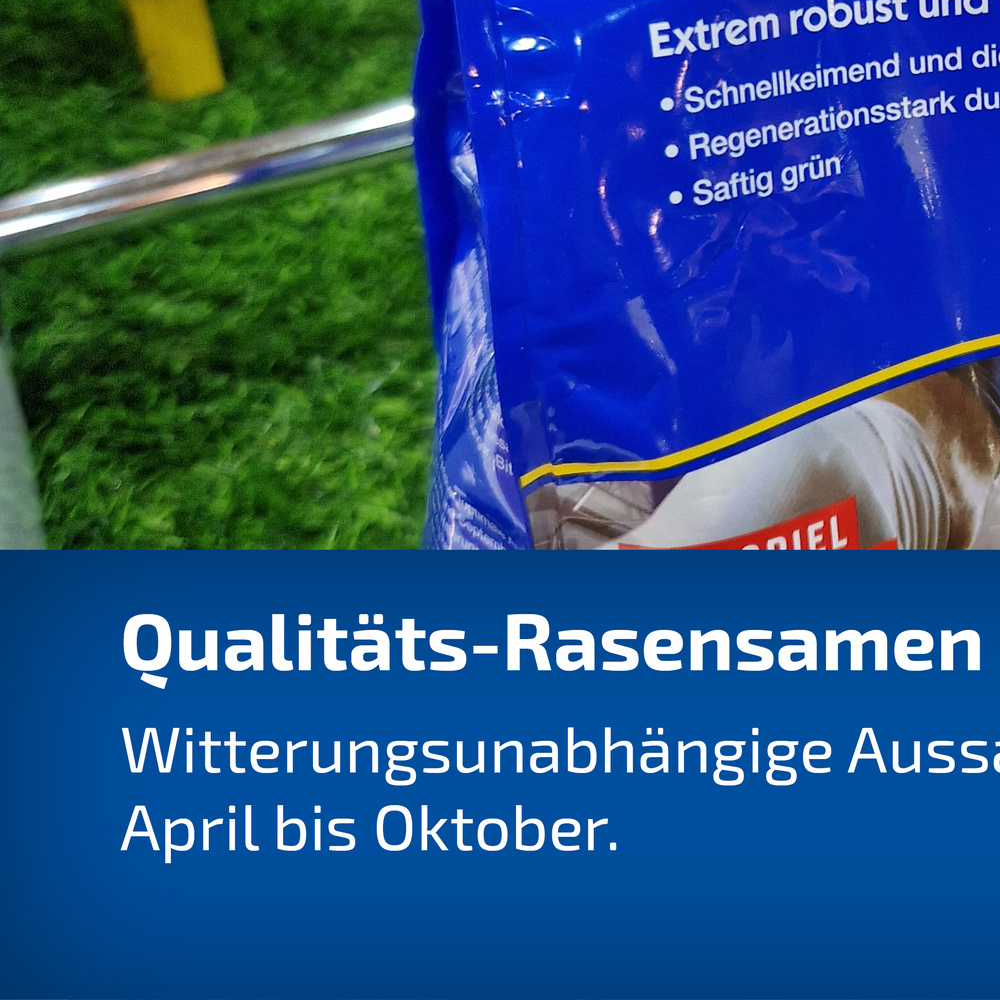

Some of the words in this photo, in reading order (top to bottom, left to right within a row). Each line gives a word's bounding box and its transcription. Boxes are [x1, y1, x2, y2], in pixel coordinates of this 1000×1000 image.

[648, 12, 780, 58] Extrem
[684, 52, 900, 114] Schnellkeimend
[909, 46, 962, 76] und
[688, 90, 957, 161] Regenerationsstark
[693, 168, 774, 206] Saftig
[781, 154, 842, 192] grün
